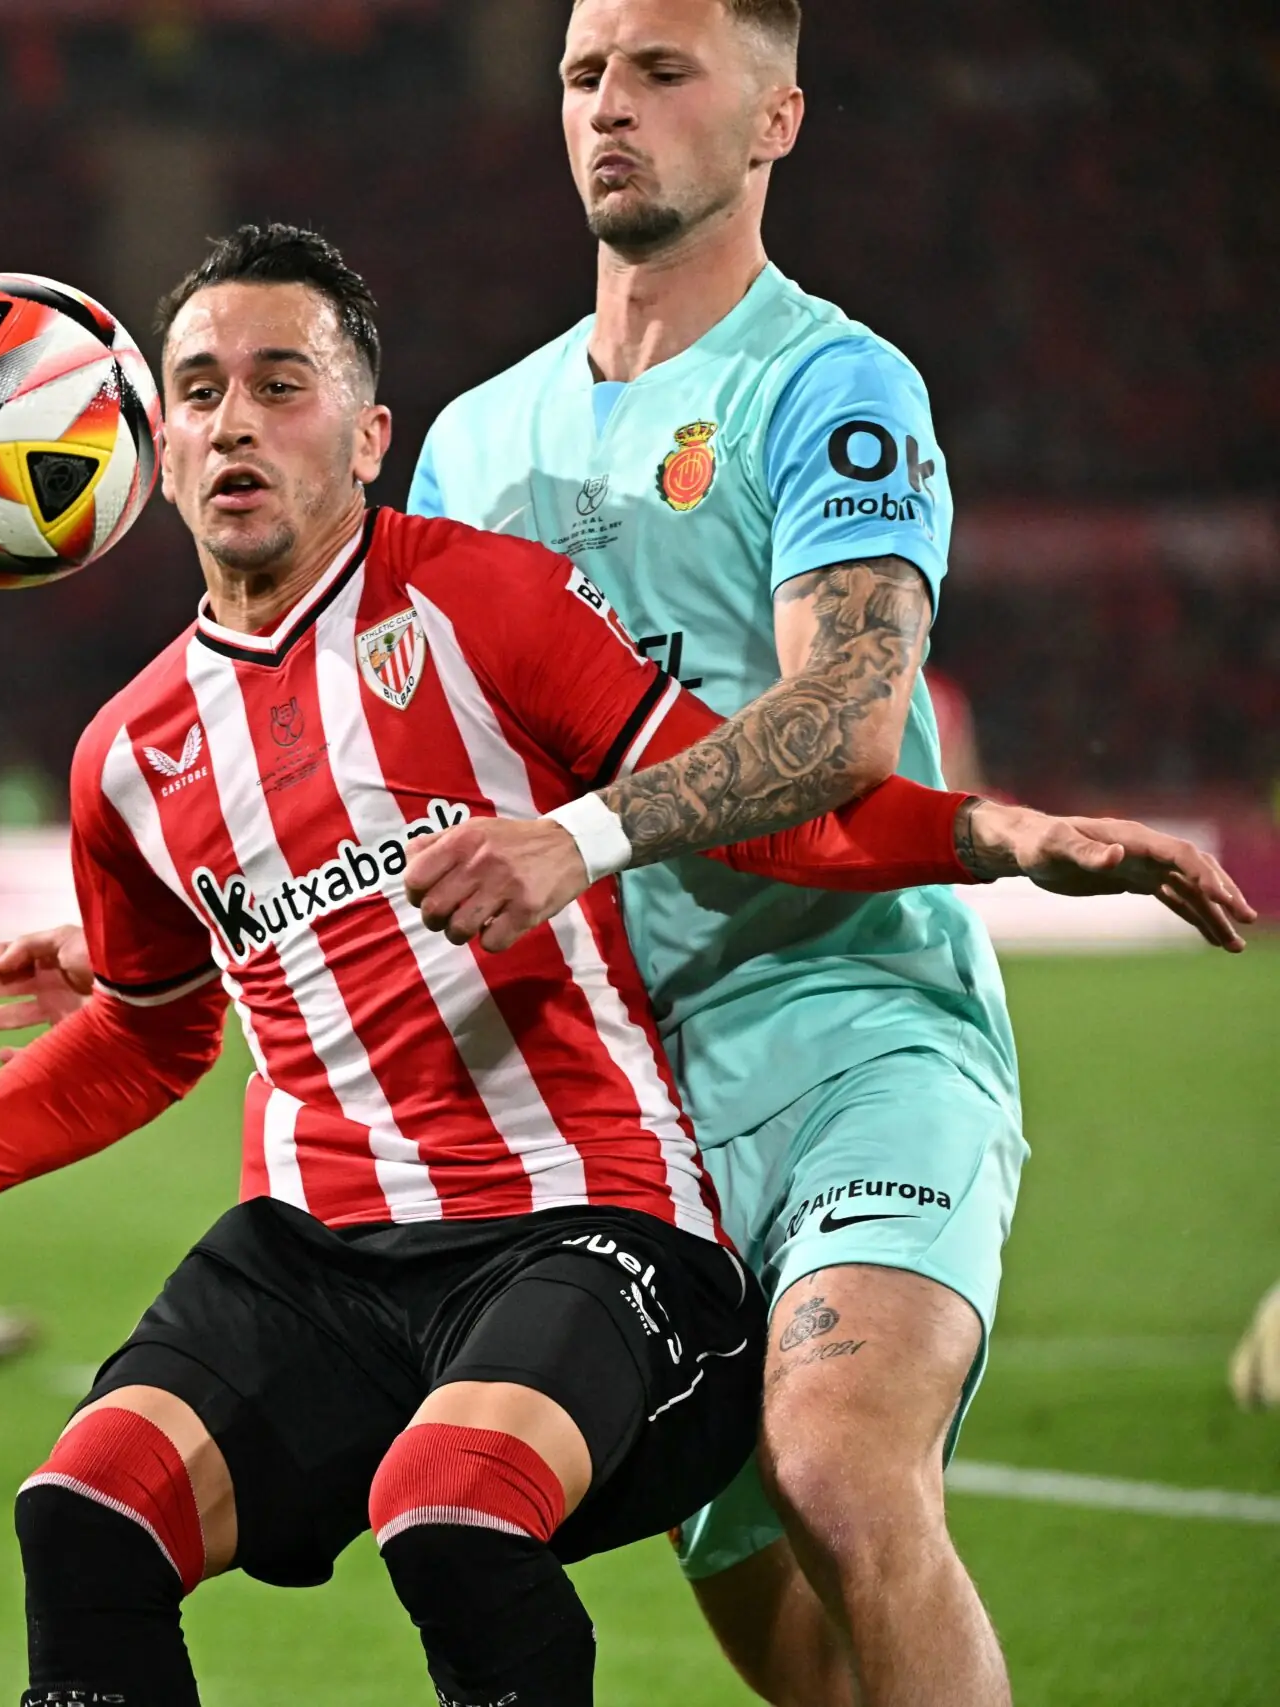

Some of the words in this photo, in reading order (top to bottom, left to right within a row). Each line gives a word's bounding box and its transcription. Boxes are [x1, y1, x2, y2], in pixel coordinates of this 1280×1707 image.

[360, 622, 395, 643] ATHLETIC
[396, 610, 418, 625] CLUB
[383, 675, 415, 706] BILBAO
[161, 766, 207, 798] CASTORE
[619, 1289, 652, 1336] CASTORE
